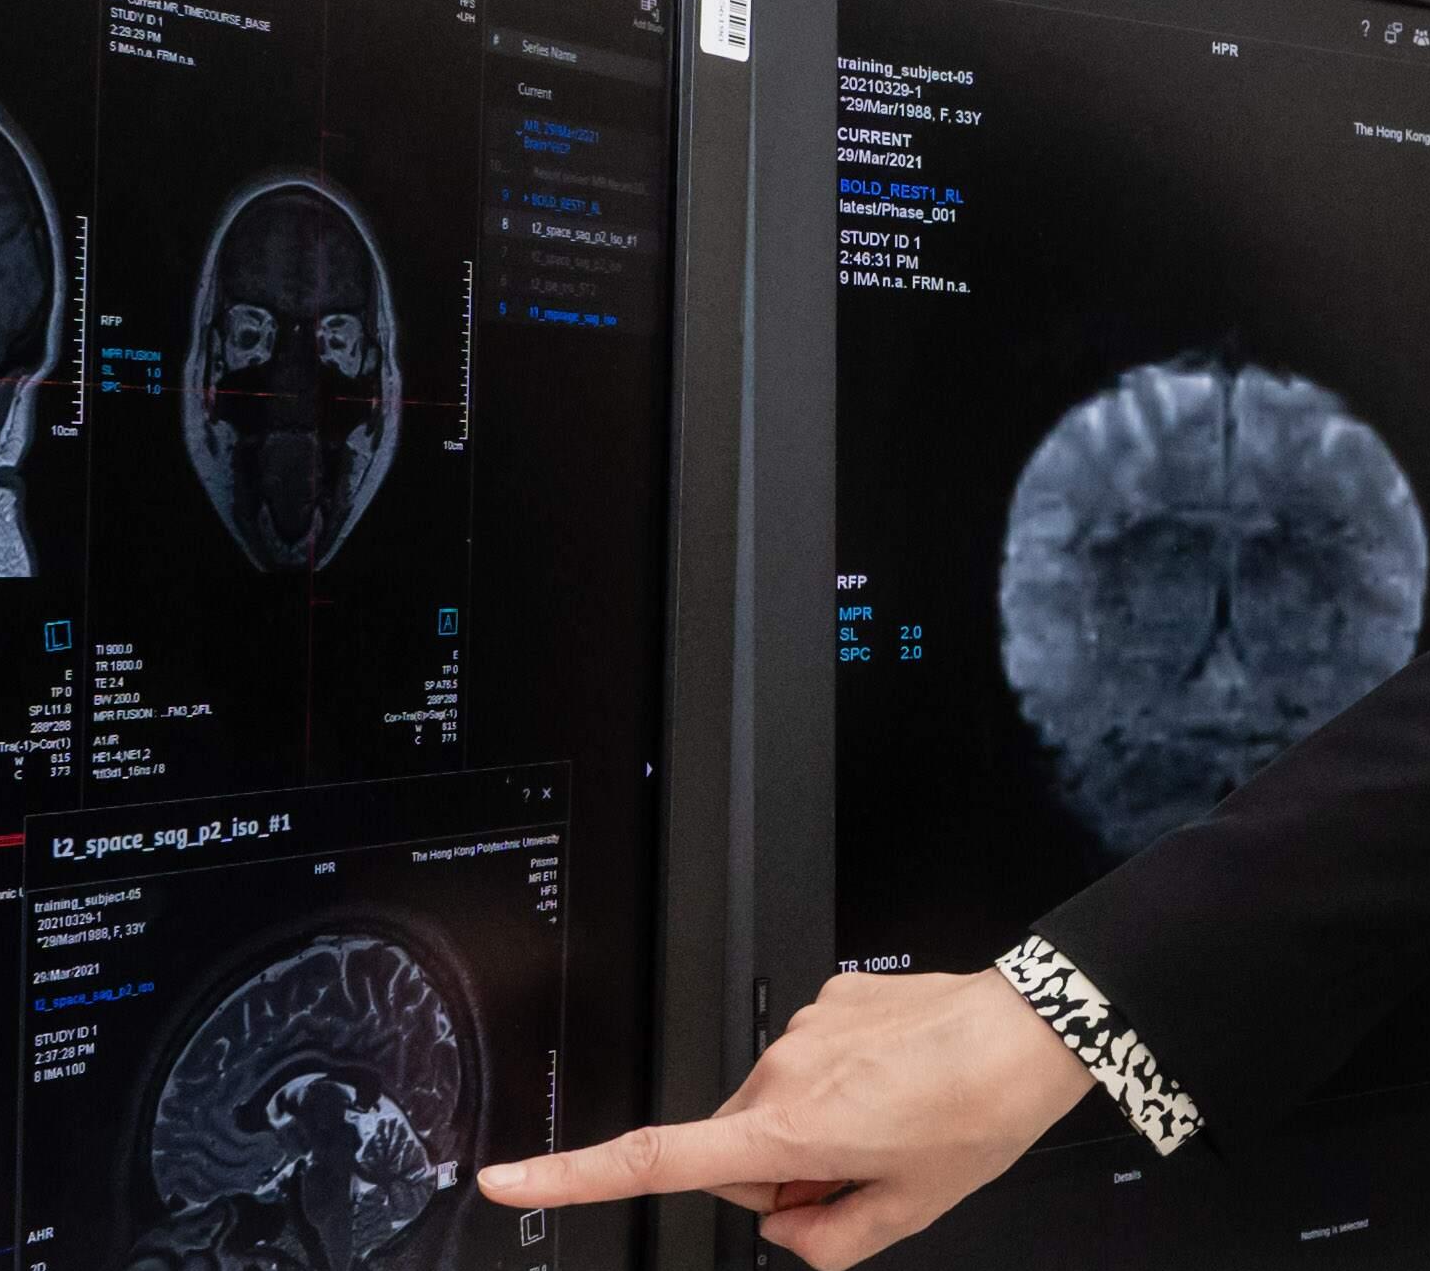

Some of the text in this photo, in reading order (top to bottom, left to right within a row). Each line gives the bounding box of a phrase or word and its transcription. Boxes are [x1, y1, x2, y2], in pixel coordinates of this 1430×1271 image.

[1212, 41, 1238, 57] HPR
[838, 56, 973, 85] training_subject-05
[840, 76, 922, 99] 20210329-1
[940, 108, 951, 124] F,
[956, 111, 982, 125] 33Y
[838, 128, 912, 148] CURRENT
[1354, 123, 1373, 137] The
[1376, 125, 1402, 143] Hong
[1405, 128, 1430, 146] Kong
[838, 148, 922, 169] 29/Mar/2021
[840, 179, 964, 204] BOLD_REST1_RL
[840, 200, 956, 223] latest/Phase_001
[840, 230, 920, 250] STUDY ID 1
[840, 250, 918, 269] 2:46:31 PM
[840, 271, 971, 293] 9 IMA n.a. FRM n.a.
[837, 575, 867, 589] RFP
[839, 607, 872, 620] MPR
[840, 626, 922, 641] SL 2.0
[840, 646, 922, 661] SPC 2.0
[52, 813, 291, 859] t2_space_sag_p2_iso_#1
[315, 862, 335, 875] HPR
[34, 887, 141, 915] training_subject-05
[38, 911, 102, 931] 20210329-1
[839, 954, 910, 973] TR 1000.0
[35, 1026, 97, 1046] STUDY ID 1
[35, 1043, 95, 1065] 2:37:28 PM
